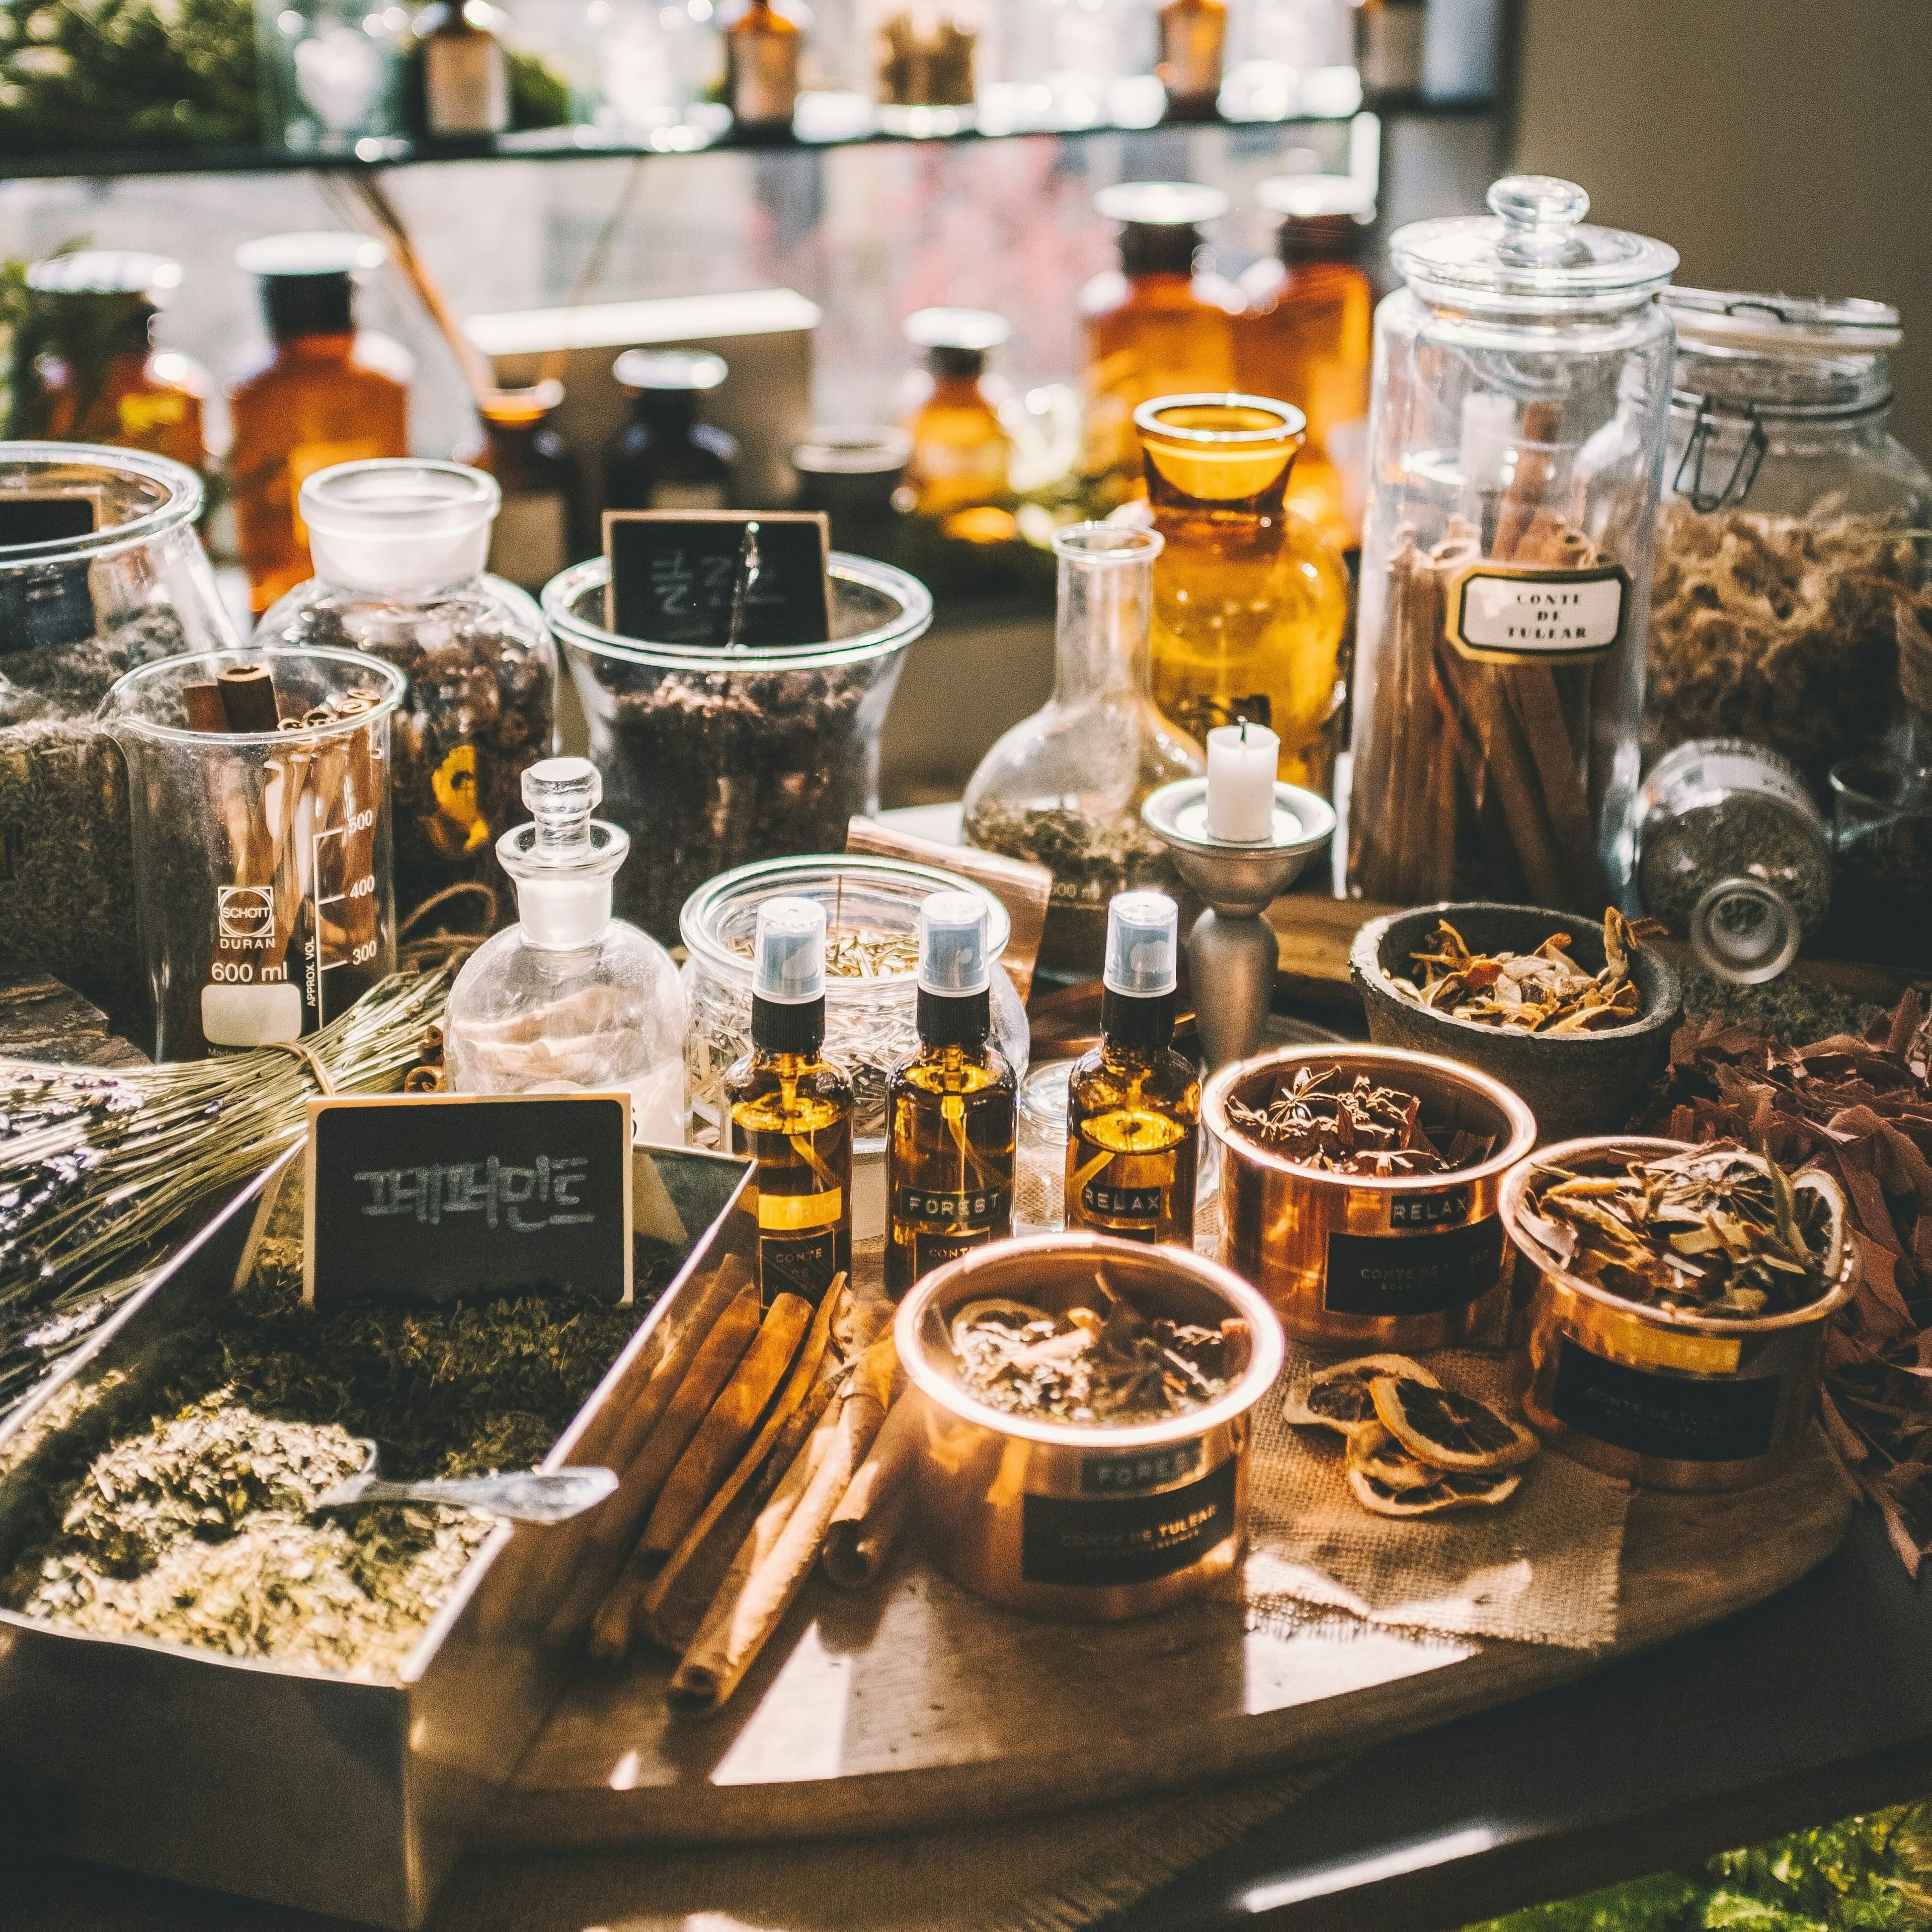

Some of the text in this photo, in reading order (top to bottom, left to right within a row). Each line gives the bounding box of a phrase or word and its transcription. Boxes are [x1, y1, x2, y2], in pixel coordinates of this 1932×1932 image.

[348, 809, 373, 835] 500
[350, 875, 375, 899] 400
[222, 906, 270, 919] SCHOTT
[219, 937, 276, 949] DURAN
[352, 940, 377, 965] 300
[211, 961, 288, 983] 600 ml
[305, 961, 316, 1006] APPROX.
[353, 1156, 596, 1232] 페퍼민트
[909, 1192, 999, 1216] FOREST
[1085, 1187, 1160, 1212] RELAX
[1393, 1196, 1467, 1221] RELAX
[775, 1247, 822, 1263] CONTE
[929, 1246, 974, 1258] CONT
[1586, 1386, 1643, 1415] CONTE
